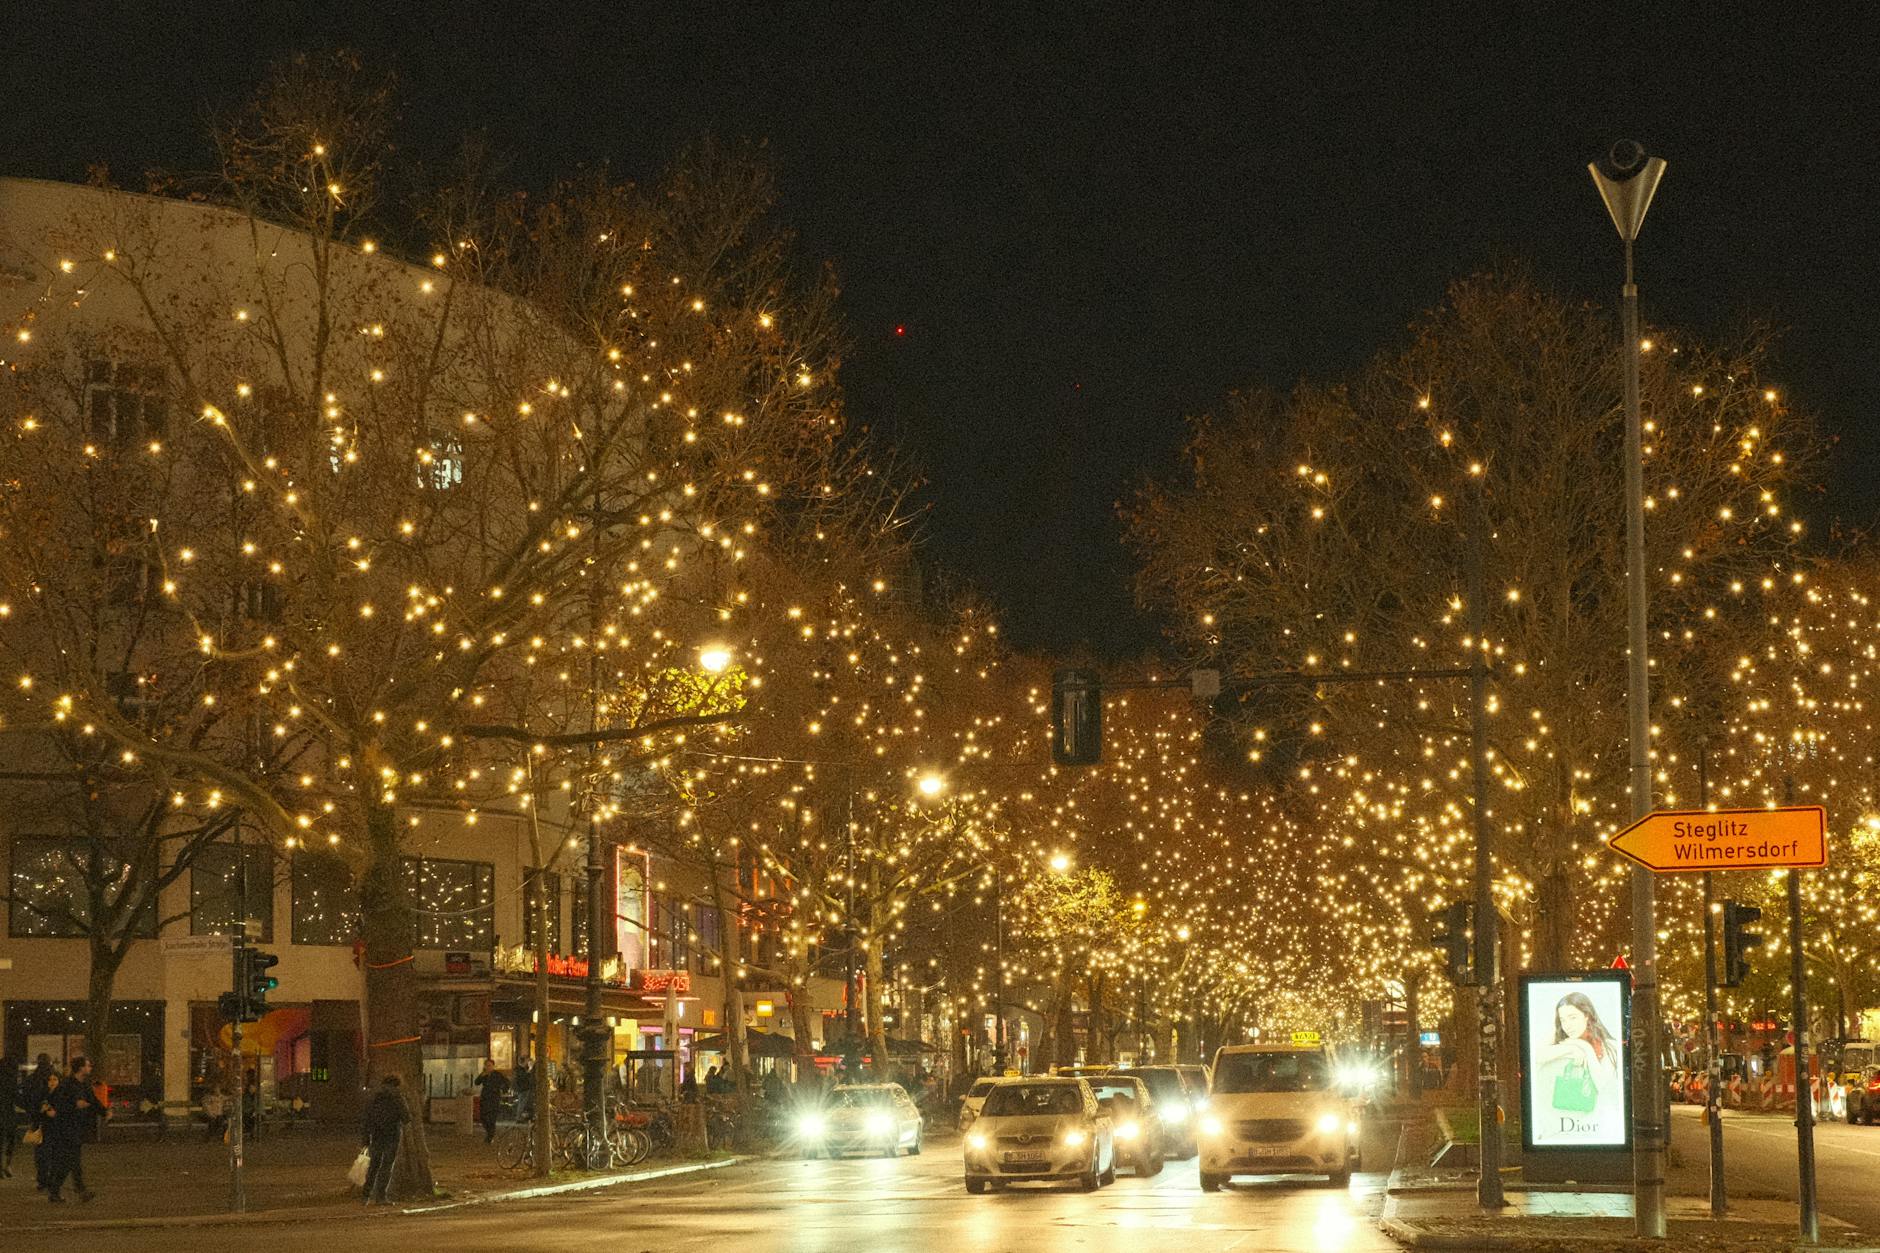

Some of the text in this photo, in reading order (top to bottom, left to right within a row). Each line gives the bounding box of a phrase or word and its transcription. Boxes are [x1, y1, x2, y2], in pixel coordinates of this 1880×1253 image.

[1673, 820, 1748, 841] Steglitz
[1674, 841, 1798, 860] Wilmersdorf
[1560, 1117, 1599, 1132] Dior
